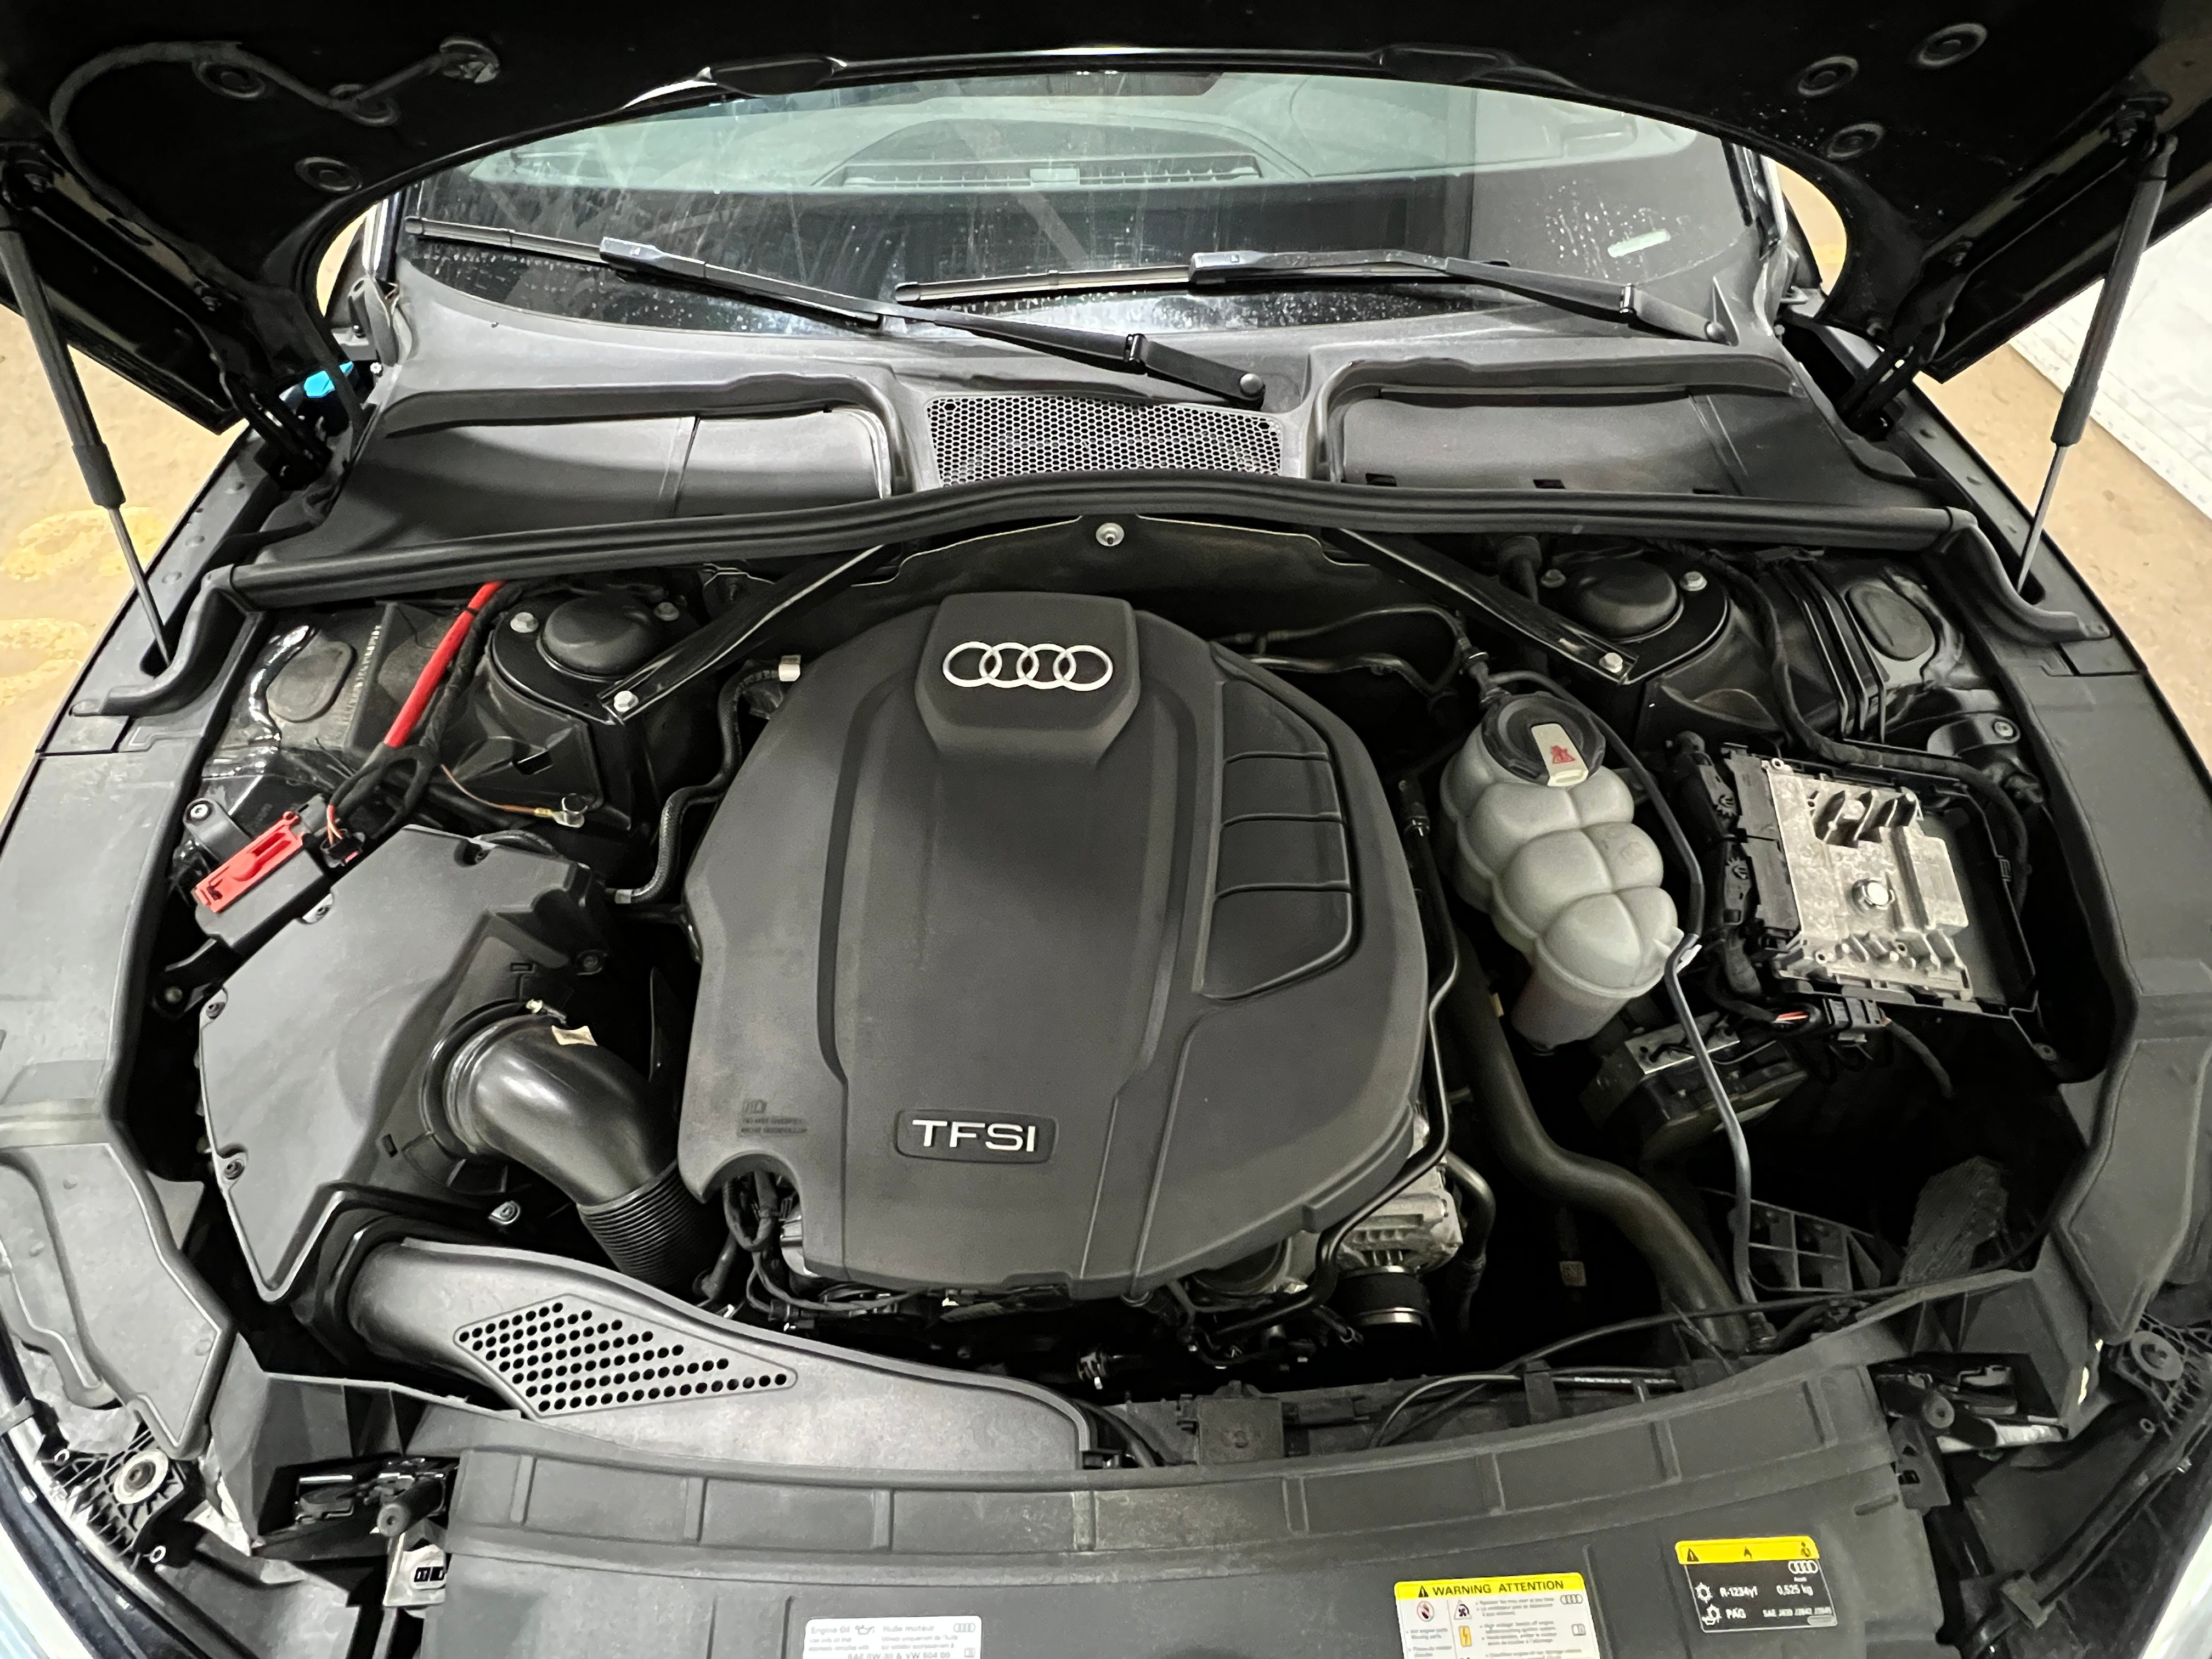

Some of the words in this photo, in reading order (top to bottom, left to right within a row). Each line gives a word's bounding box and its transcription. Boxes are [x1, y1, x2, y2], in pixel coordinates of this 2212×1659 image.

[912, 1119, 1036, 1152] TFSI
[1432, 1583, 1492, 1596] WARNING
[1498, 1580, 1564, 1593] ATTENTION
[1801, 1584, 1814, 1596] kg
[1725, 1607, 1747, 1619] PAG
